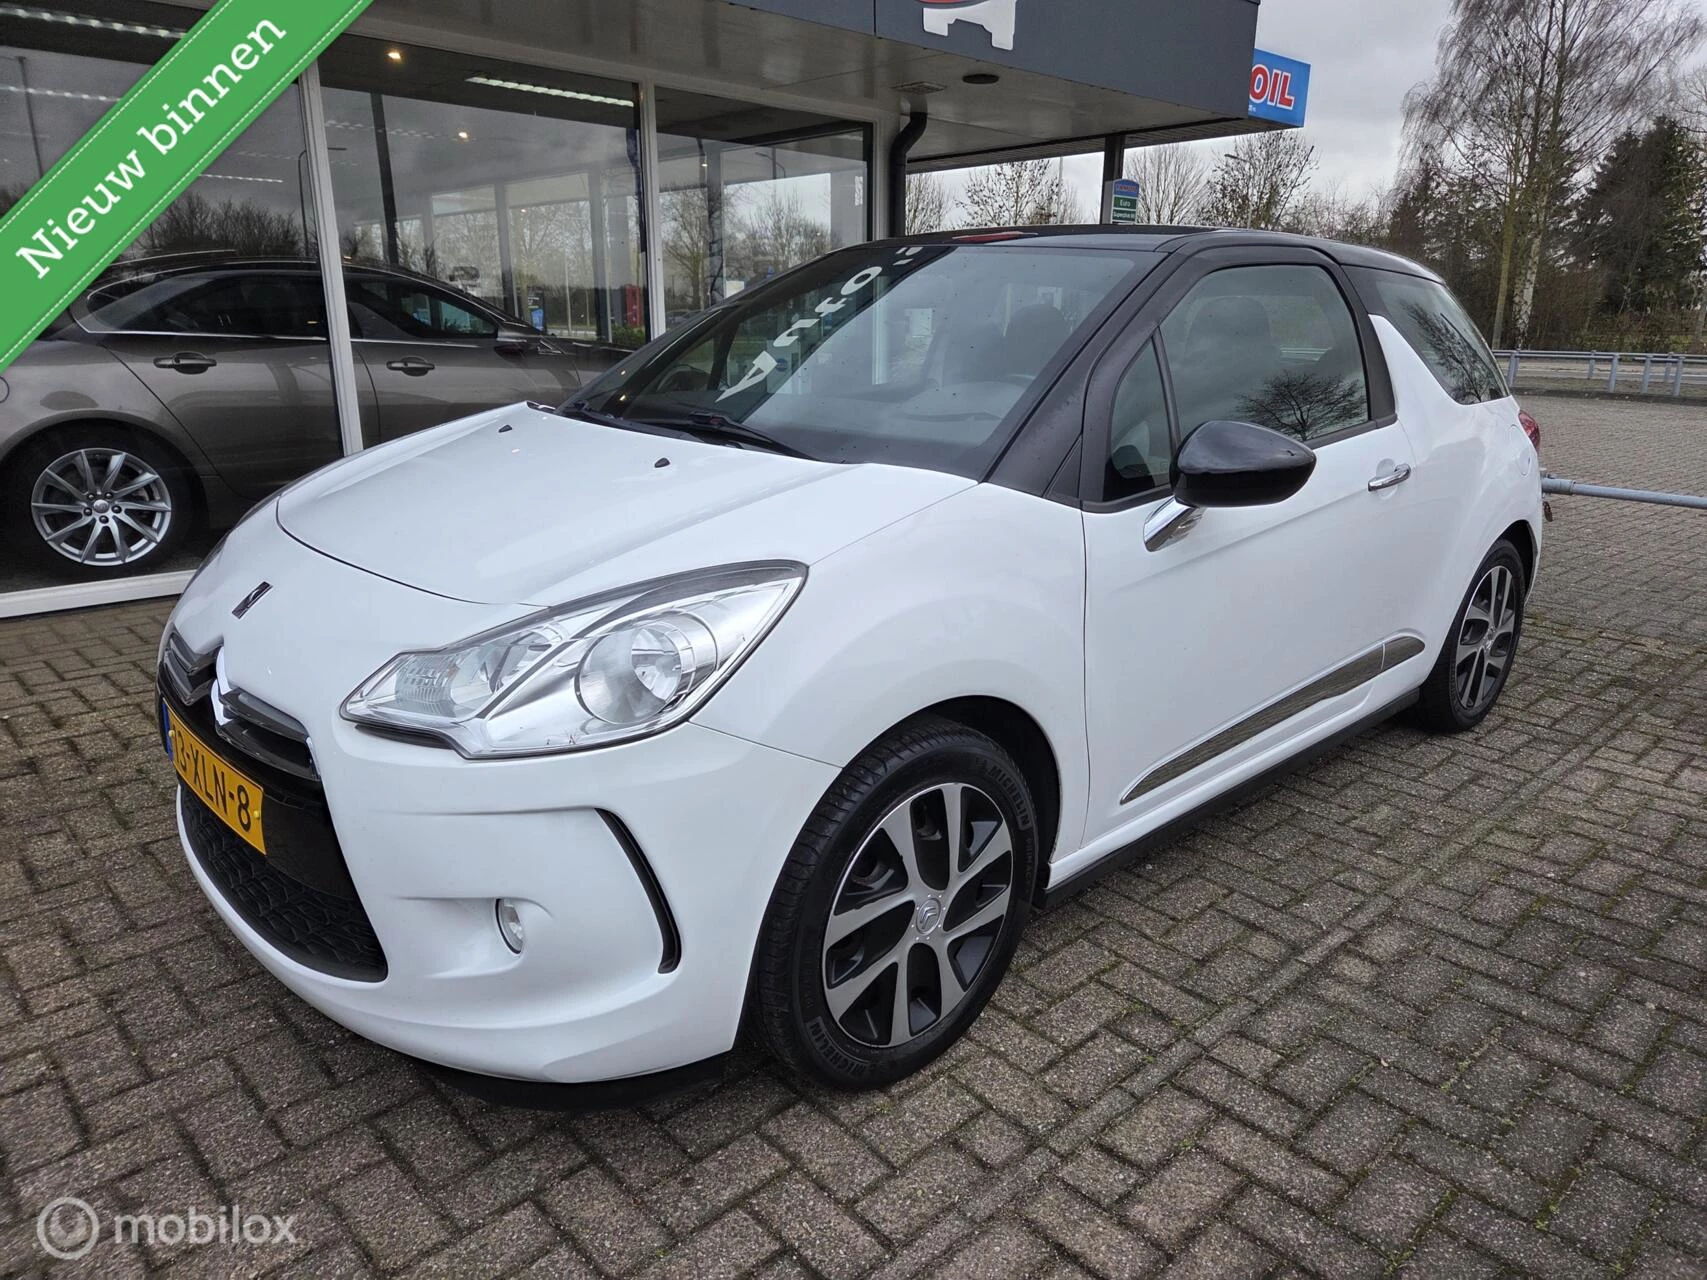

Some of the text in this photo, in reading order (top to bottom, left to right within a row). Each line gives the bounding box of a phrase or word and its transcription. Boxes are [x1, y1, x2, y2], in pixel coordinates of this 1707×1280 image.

[1249, 64, 1295, 110] OIL
[1120, 199, 1131, 207] Euro
[989, 765, 1031, 827] MICHELIN
[808, 1021, 867, 1074] MICHELIN
